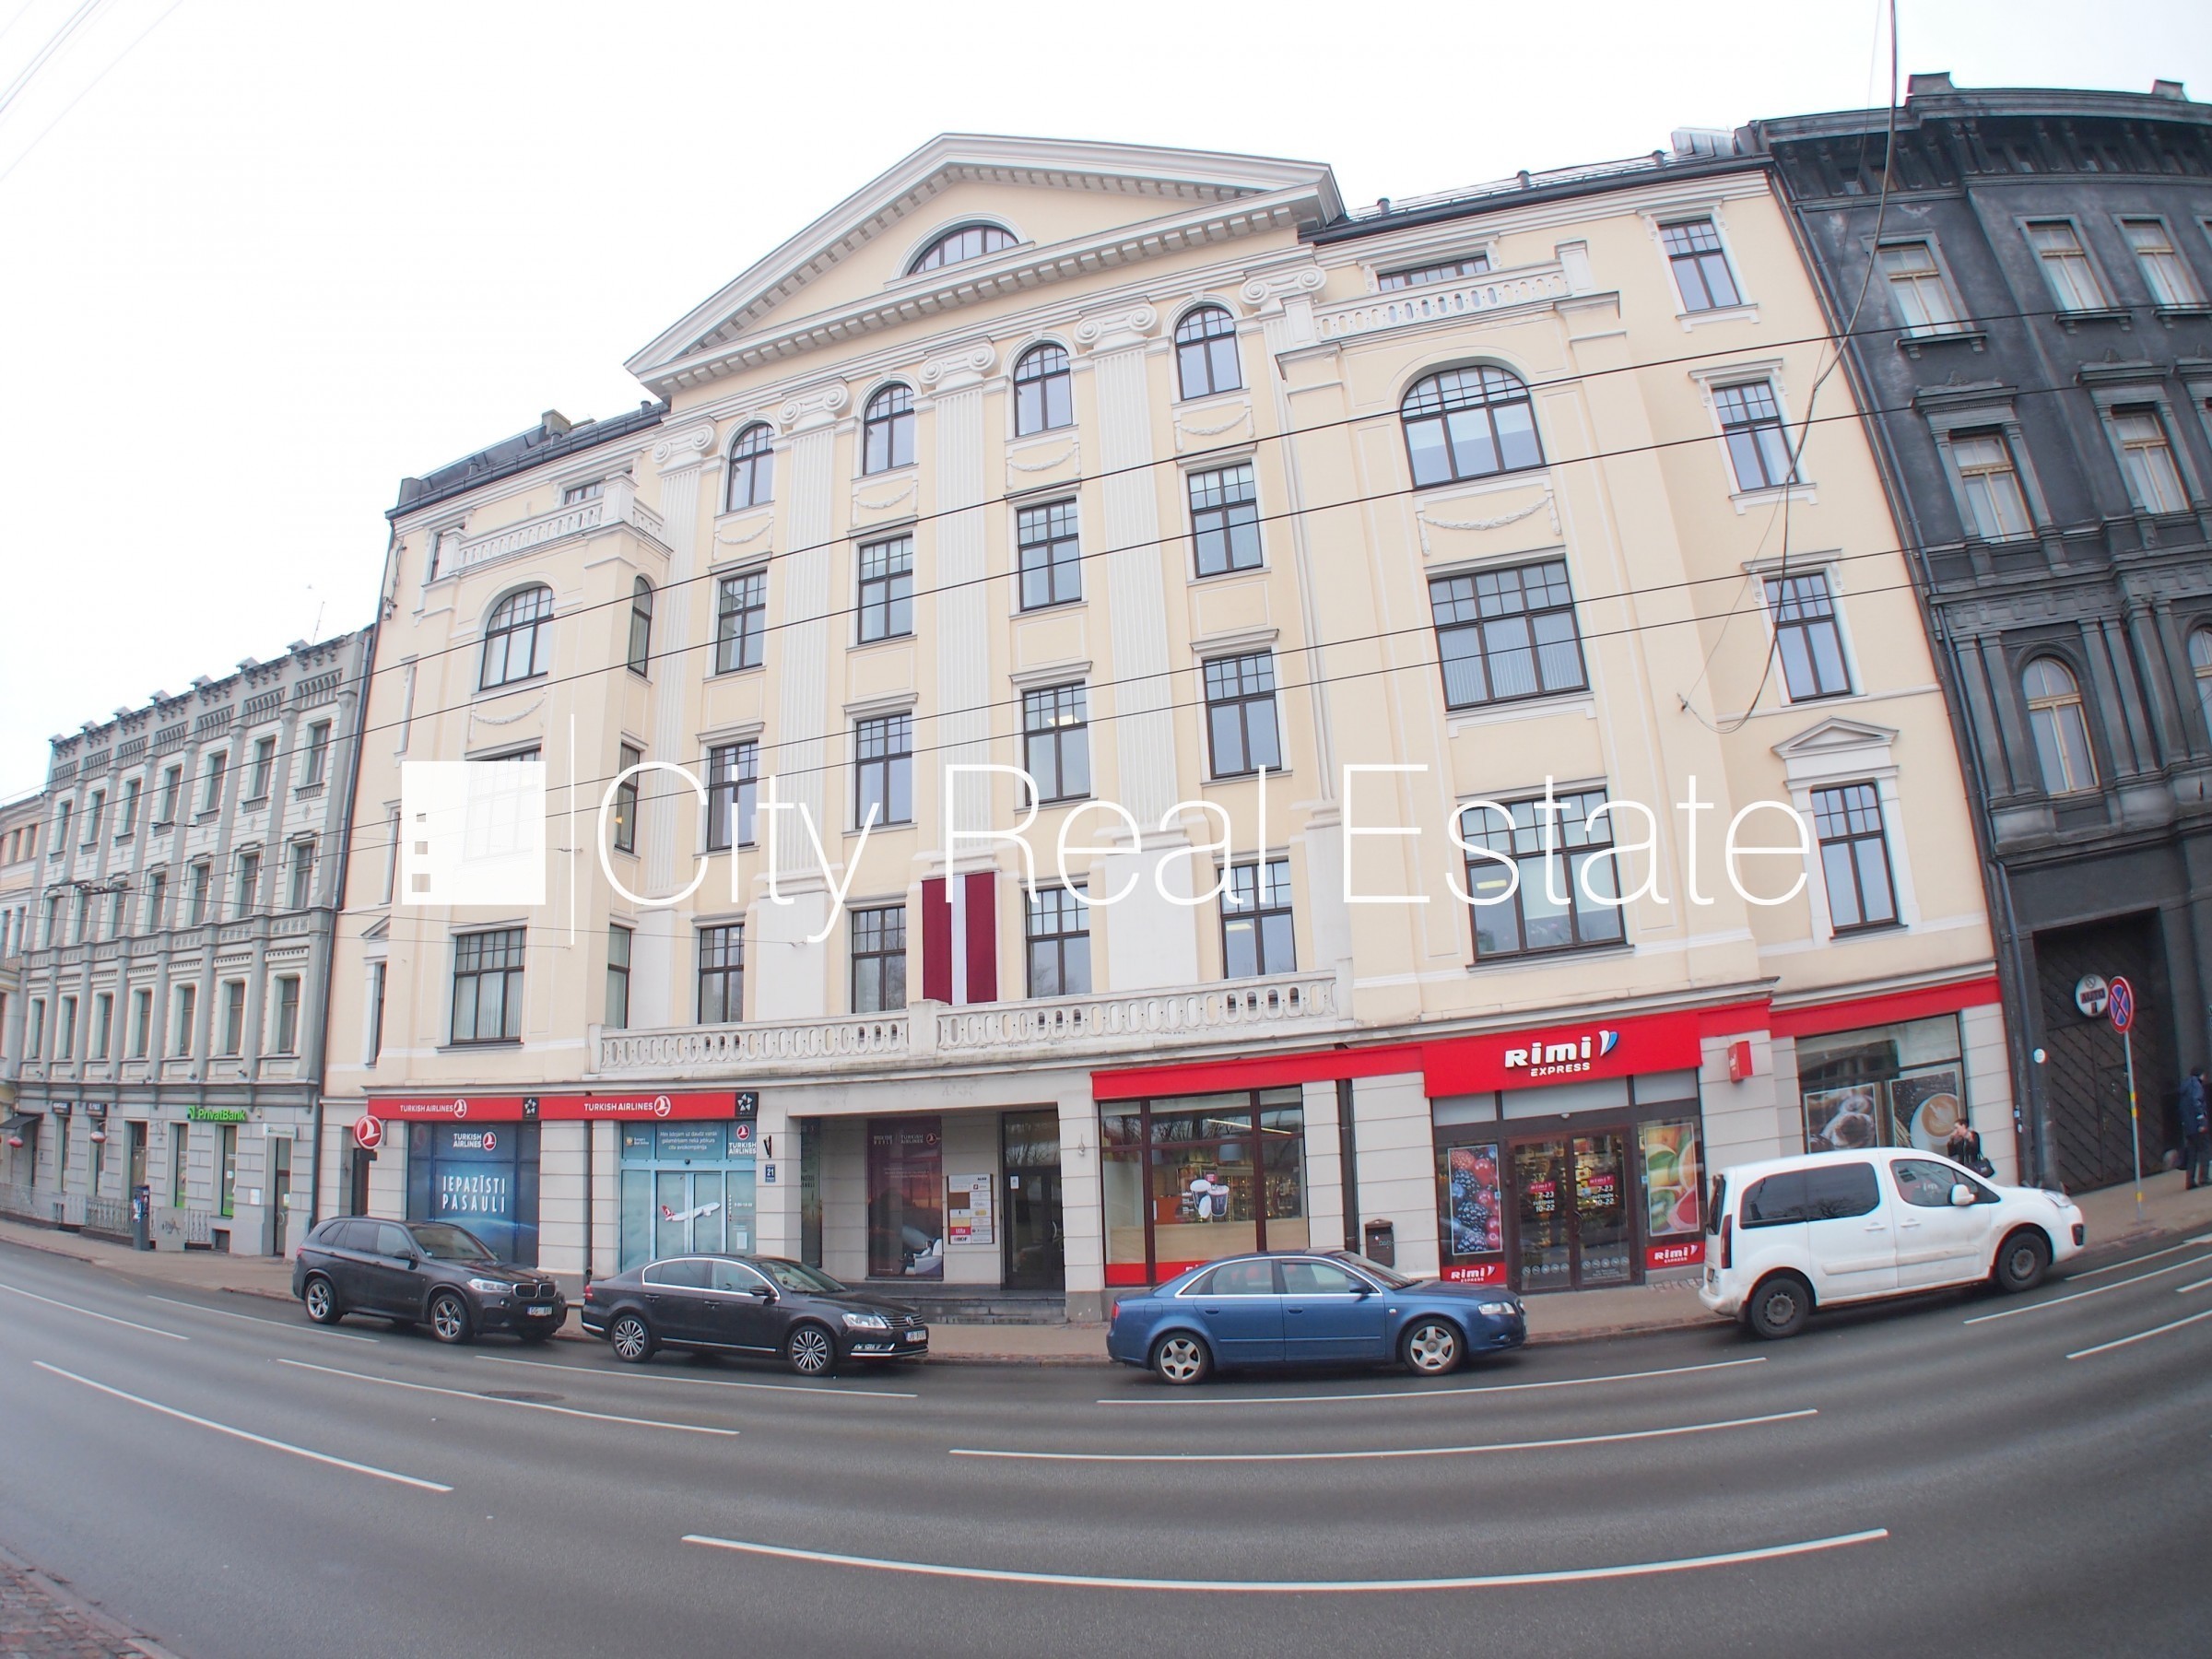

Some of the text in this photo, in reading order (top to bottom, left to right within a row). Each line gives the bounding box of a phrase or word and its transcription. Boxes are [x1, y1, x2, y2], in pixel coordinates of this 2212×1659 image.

[1530, 1062, 1591, 1077] EXPRESS
[426, 1104, 453, 1112] AIRLINES
[618, 1102, 653, 1111] AIRLINES
[197, 1108, 246, 1121] PrivatBank
[766, 1168, 774, 1177] 21
[442, 1175, 505, 1194] IEPAZĪSTI
[442, 1194, 505, 1213] PASAULI
